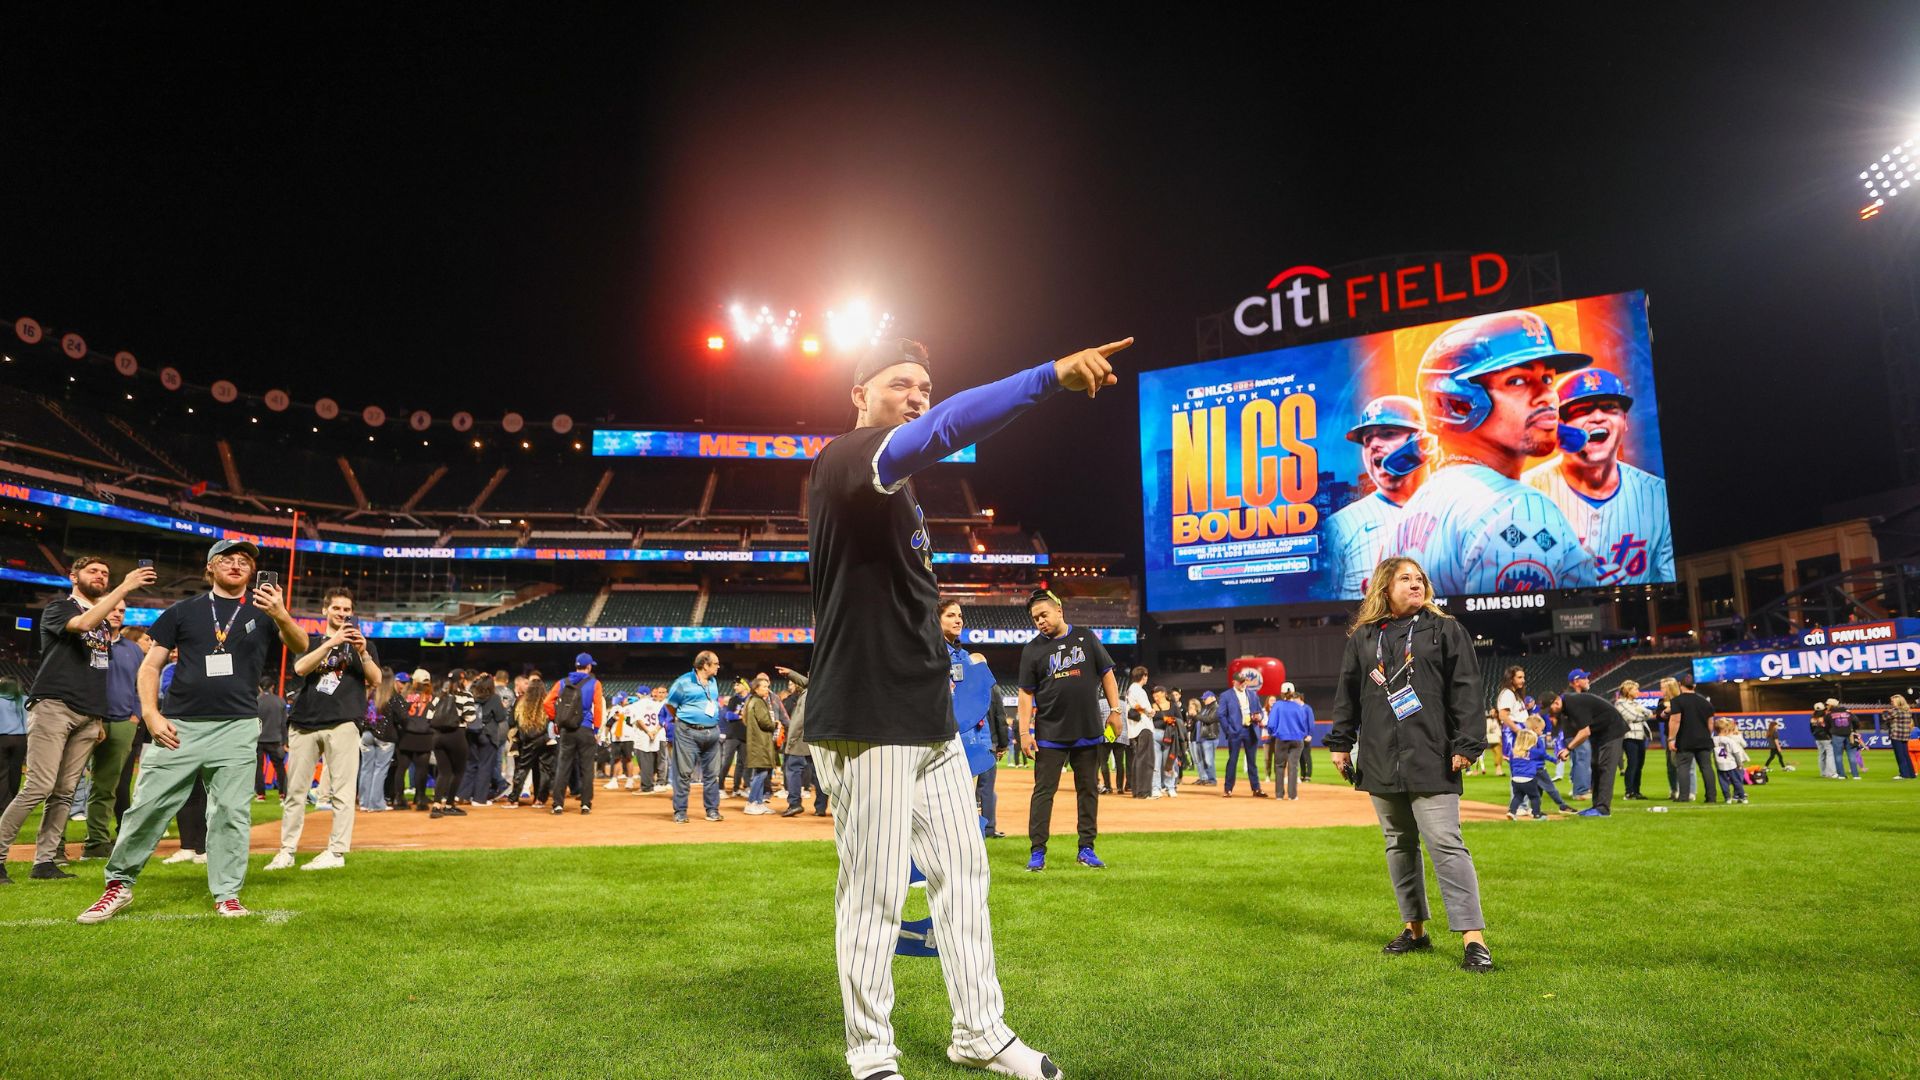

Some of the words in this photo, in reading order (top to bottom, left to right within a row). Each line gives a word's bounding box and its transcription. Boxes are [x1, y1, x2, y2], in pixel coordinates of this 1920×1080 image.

[1233, 277, 1330, 336] citi
[1346, 252, 1509, 318] FIELD
[23, 324, 35, 338] 16
[67, 339, 81, 353] 24
[120, 357, 132, 370] 17
[1172, 400, 1204, 412] NEW
[1216, 392, 1259, 405] YORK
[1271, 383, 1316, 397] METS
[1205, 383, 1233, 397] NLCS
[700, 435, 796, 458] METS
[1172, 392, 1319, 515] NLCS
[1172, 503, 1319, 545] BOUND
[383, 547, 456, 559] CLINCHED!
[684, 550, 753, 561] CLINCHED!
[970, 554, 1036, 564] CLINCHED!
[1465, 594, 1546, 612] SAMSUNG
[517, 626, 628, 643] CLINCHED!
[750, 627, 807, 643] METS
[1804, 631, 1825, 646] citi
[1831, 626, 1892, 643] PAVILION
[1047, 645, 1086, 677] Mets
[1760, 642, 1920, 677] CLINCHED
[643, 713, 657, 727] 39
[1718, 747, 1728, 760] 4
